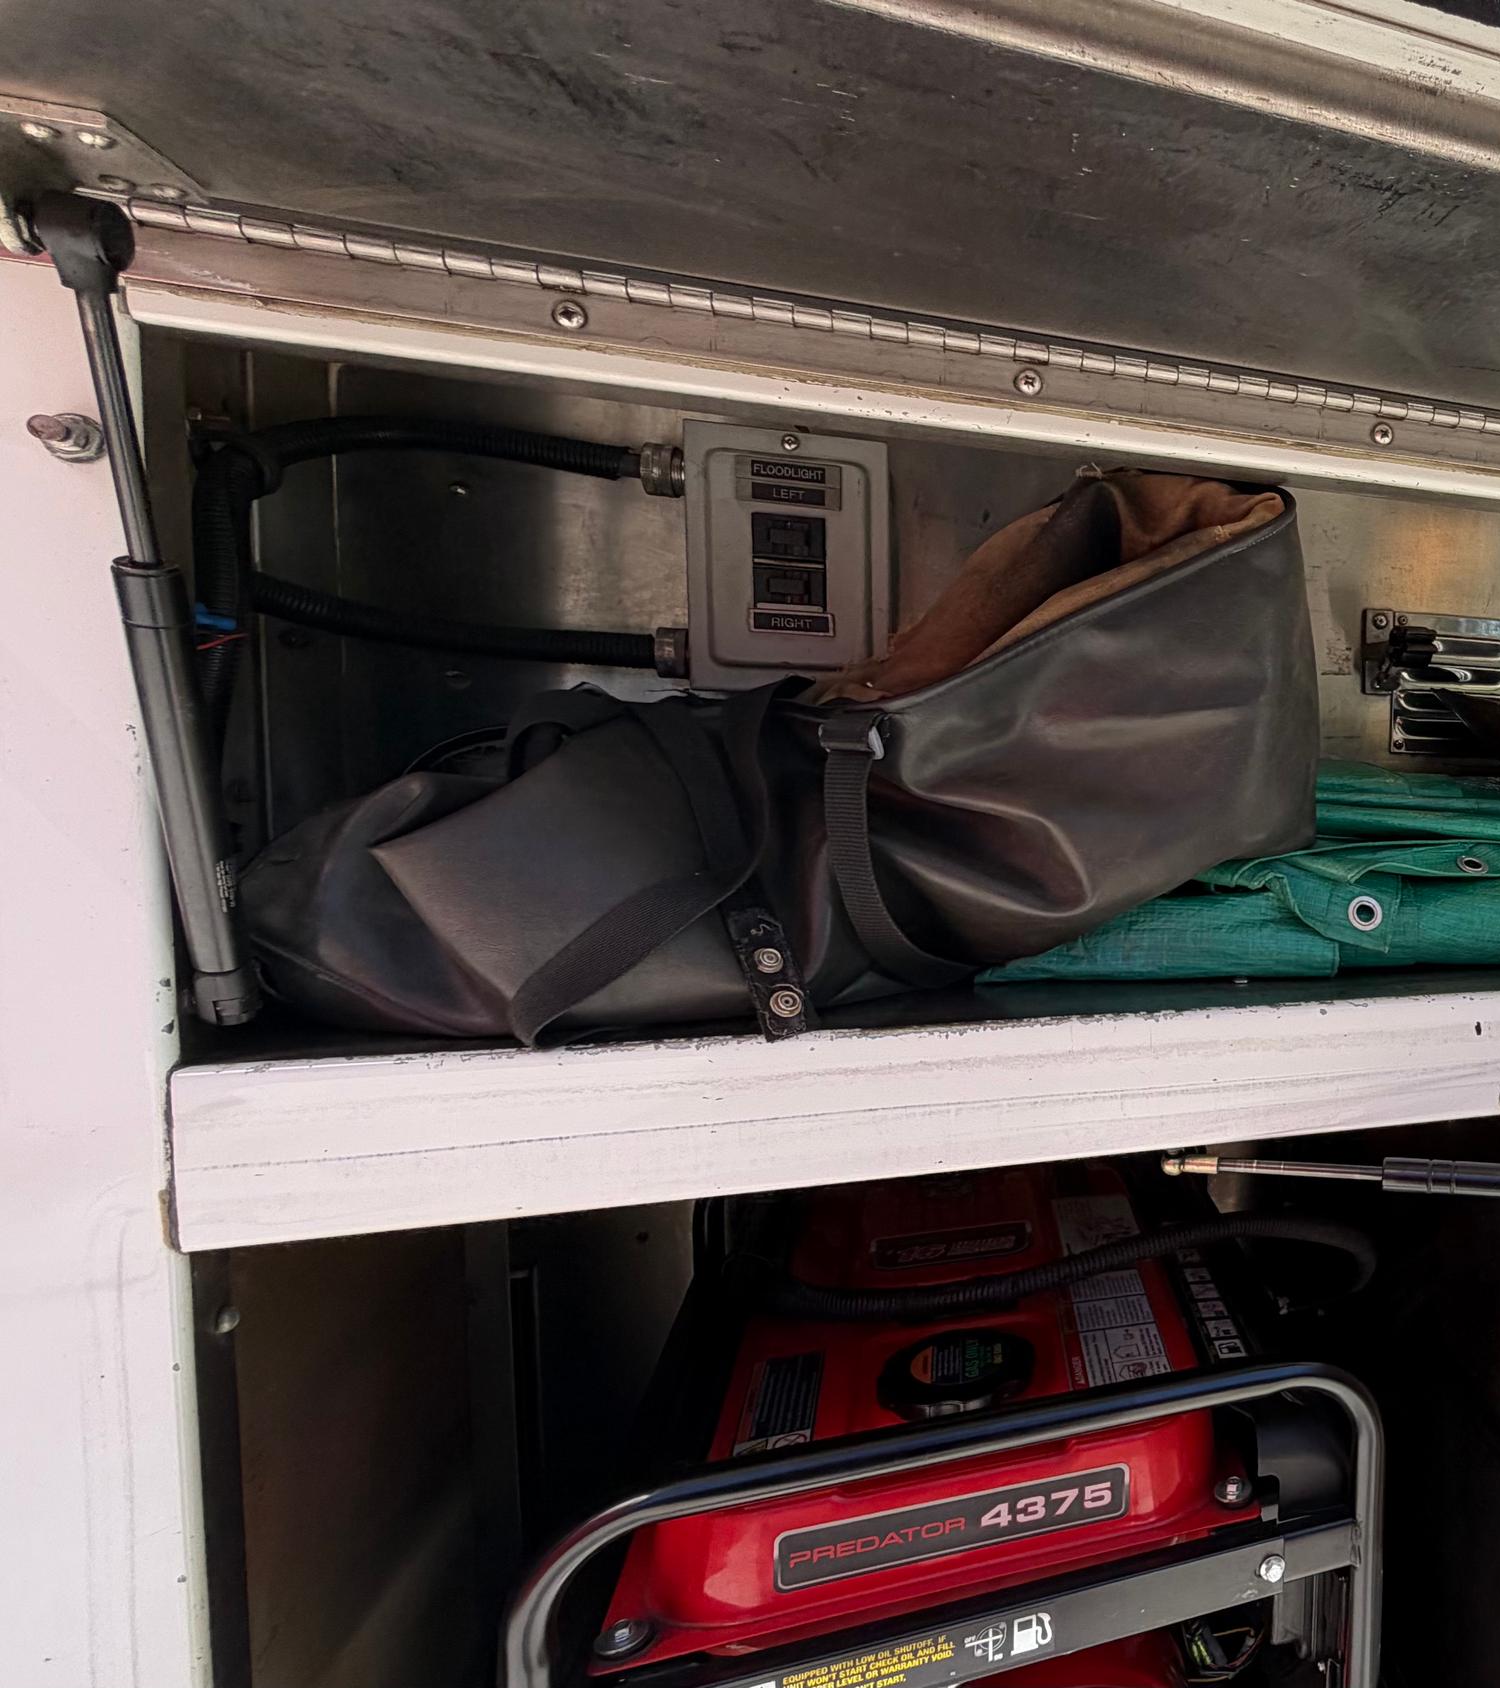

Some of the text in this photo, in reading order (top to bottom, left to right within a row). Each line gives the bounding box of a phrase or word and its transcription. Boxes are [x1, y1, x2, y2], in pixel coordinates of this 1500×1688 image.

[753, 463, 823, 481] FLOODLIGHT
[772, 487, 805, 500] LEFT
[771, 616, 813, 630] RIGHT
[789, 1482, 1113, 1569] PREDATOR 4375
[782, 1666, 828, 1685] EQUIPPED
[830, 1660, 854, 1672] WITH
[855, 1653, 876, 1666] LOW
[877, 1650, 892, 1660] OIL
[938, 1634, 947, 1643] IF
[807, 1672, 837, 1687] WON'T
[839, 1664, 867, 1679] START
[869, 1656, 899, 1670] CHECK
[901, 1652, 915, 1661] OIL
[917, 1646, 936, 1657] AND
[937, 1641, 956, 1652] FILL
[836, 1674, 864, 1688] LEVEL
[865, 1669, 879, 1680] OR
[880, 1655, 930, 1676] WARRANTY
